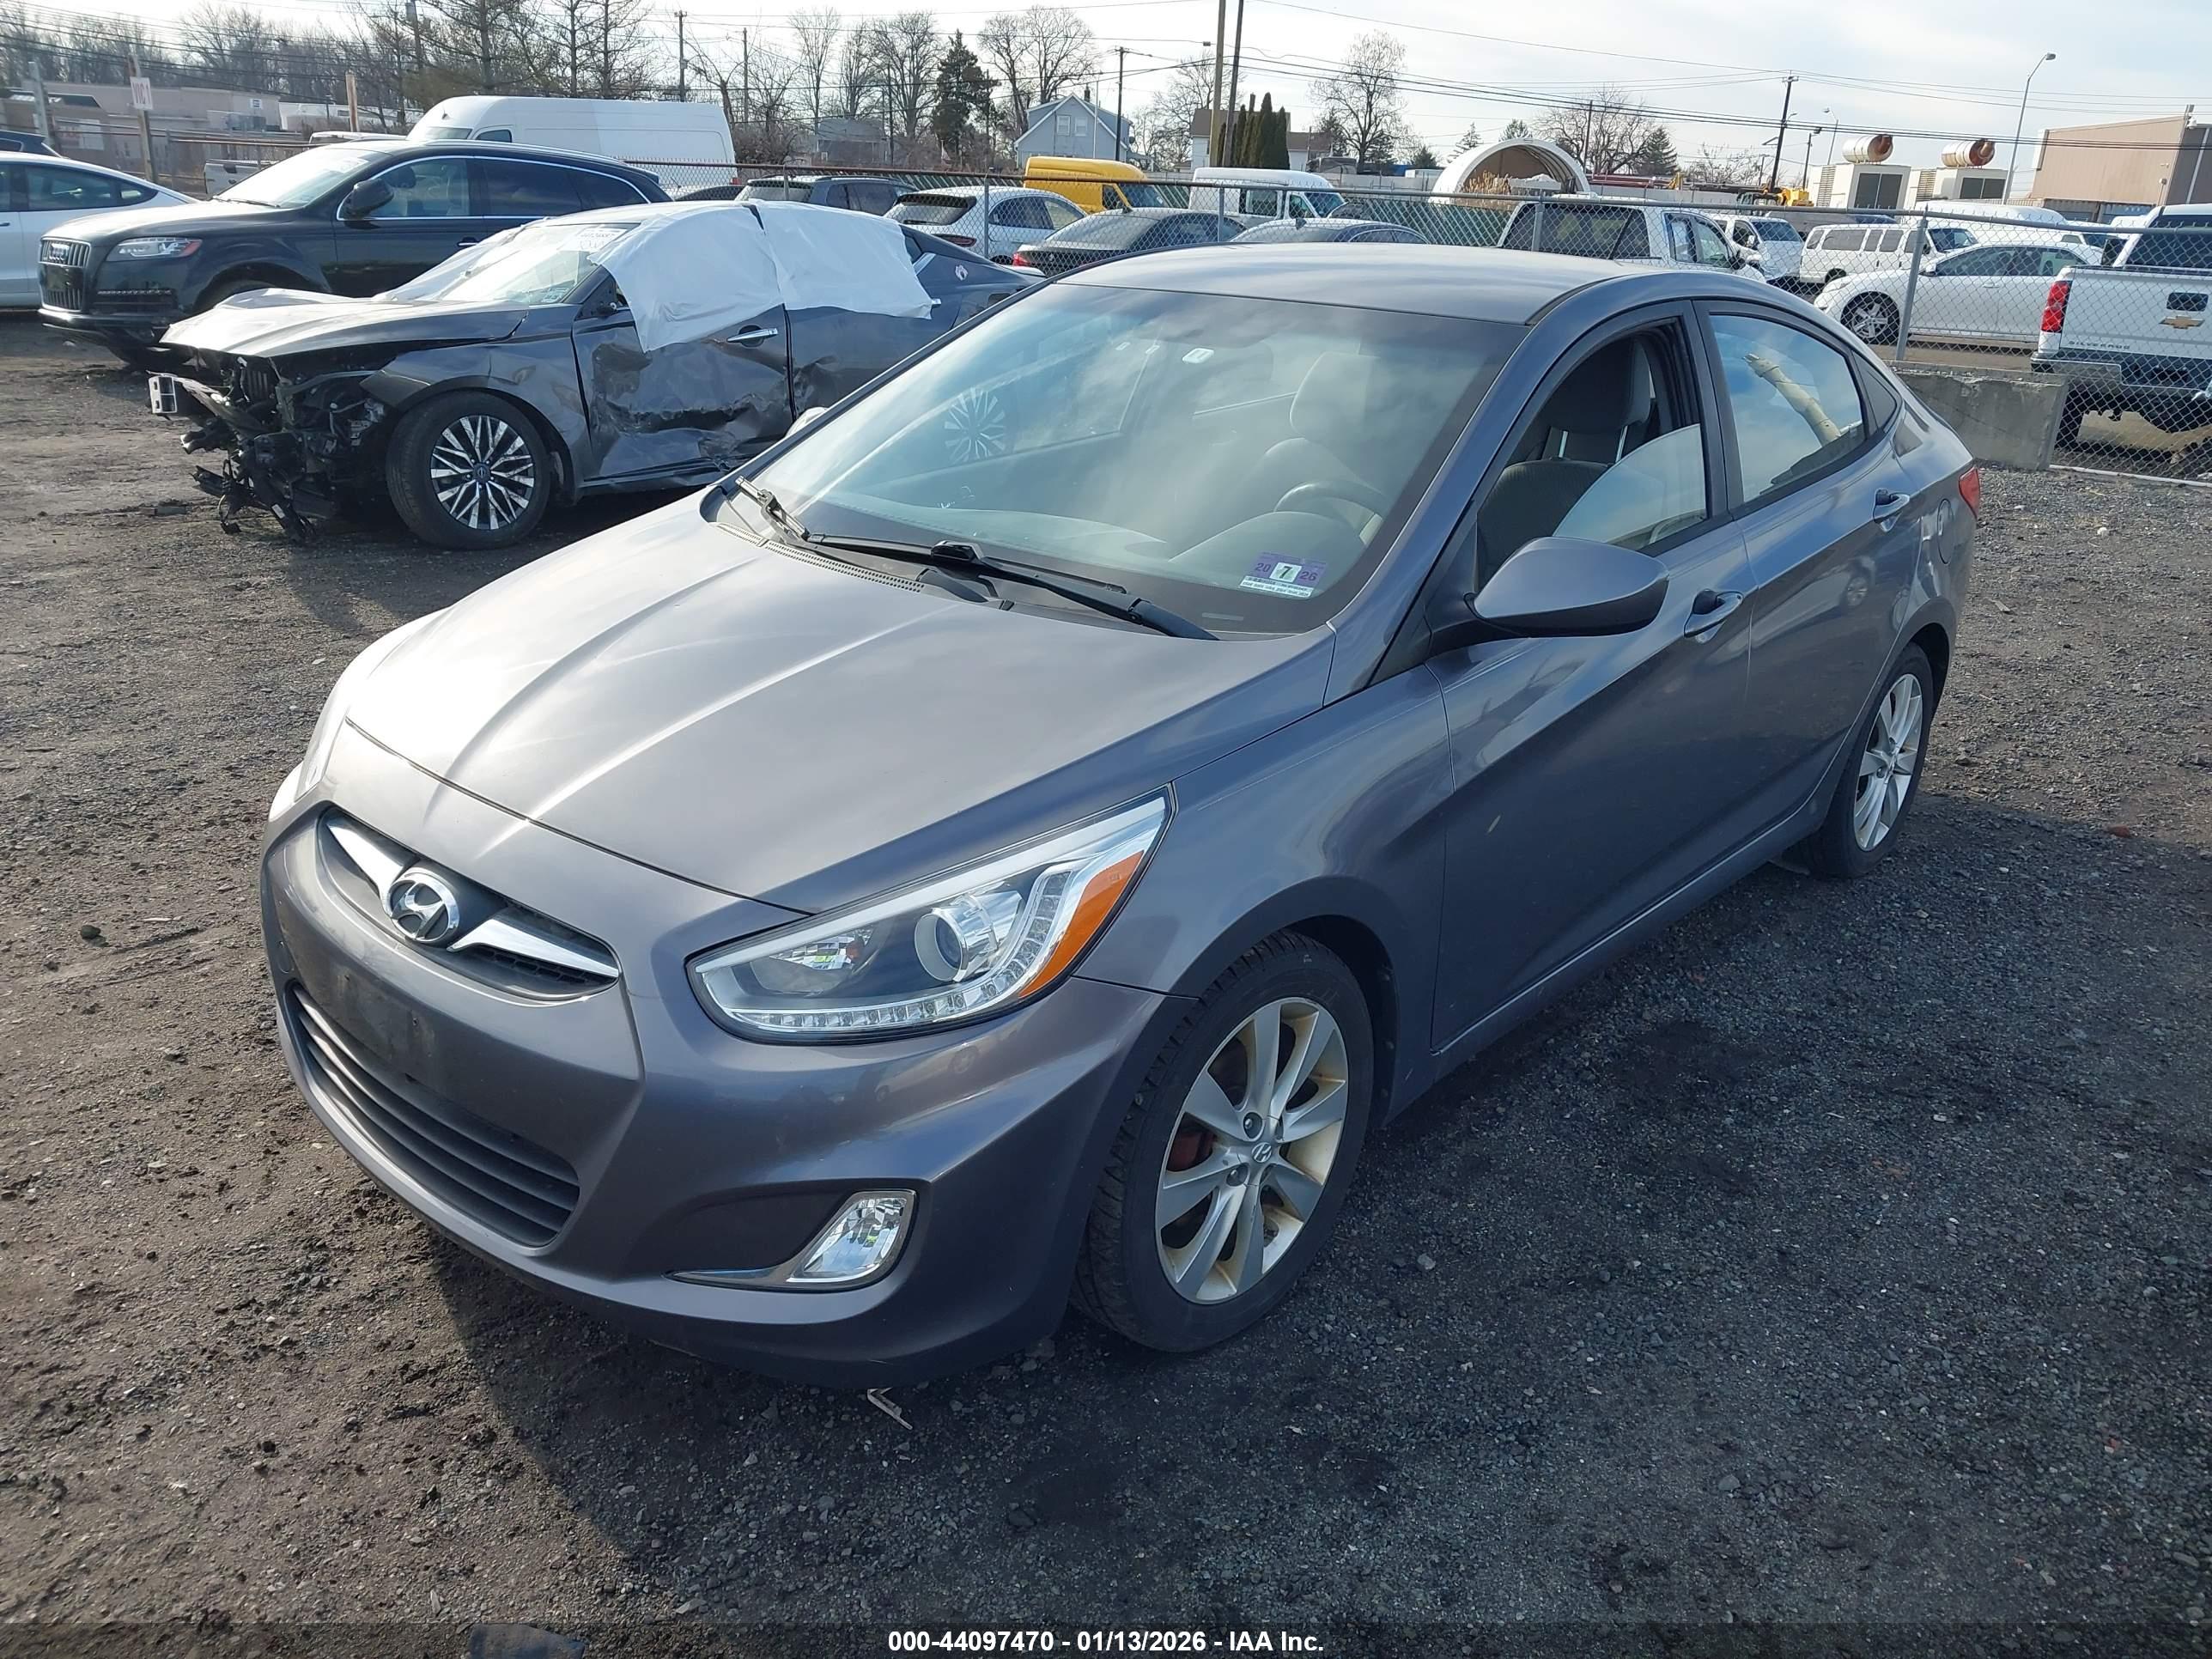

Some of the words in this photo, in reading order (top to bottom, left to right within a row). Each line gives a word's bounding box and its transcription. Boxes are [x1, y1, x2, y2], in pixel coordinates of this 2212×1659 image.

[2068, 340, 2131, 349] SILVERADO
[1255, 562, 1272, 573] 20
[1279, 565, 1292, 579] 7
[1299, 571, 1318, 581] 26
